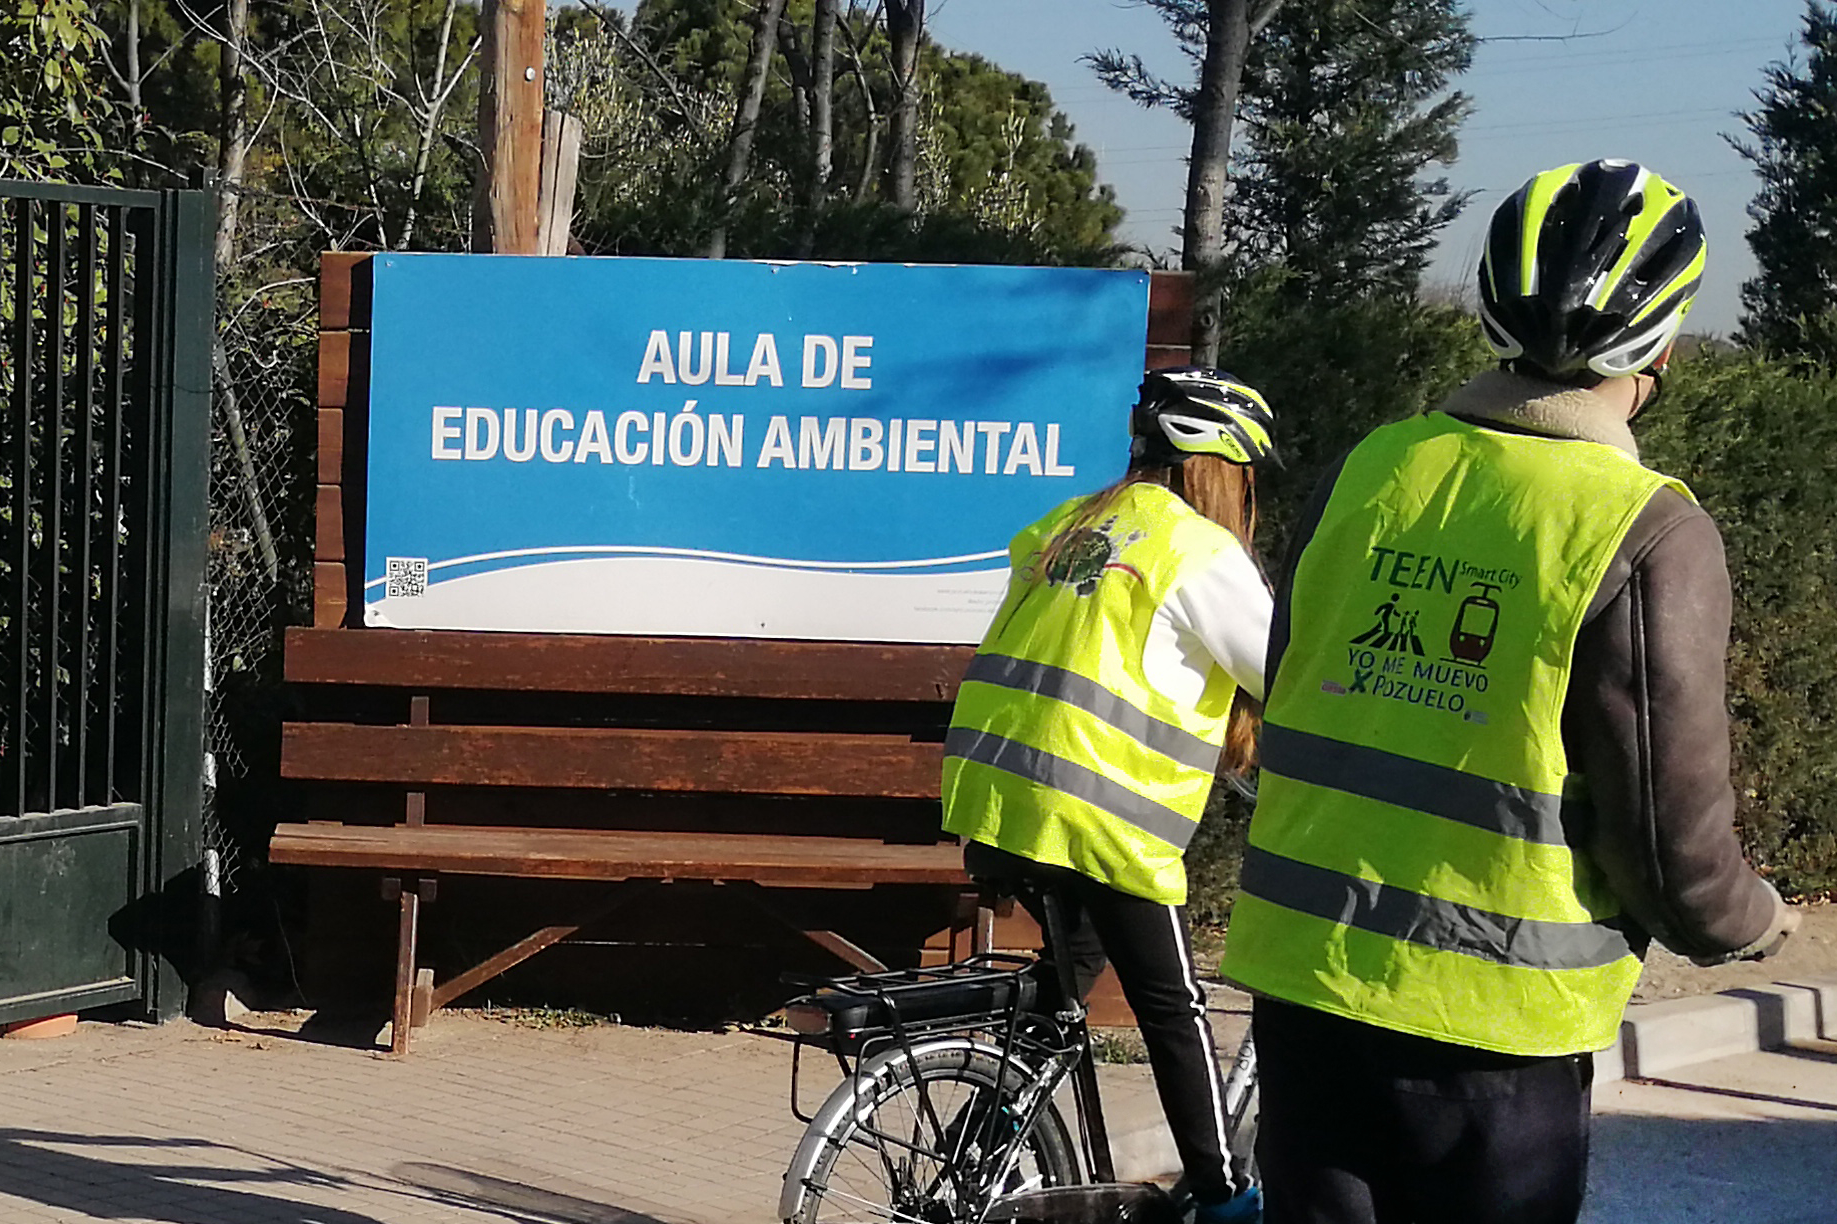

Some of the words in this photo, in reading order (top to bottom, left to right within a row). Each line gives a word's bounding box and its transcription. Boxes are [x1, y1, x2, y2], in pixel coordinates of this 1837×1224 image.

[637, 329, 783, 389] AULA
[801, 334, 874, 390] DE
[430, 399, 744, 469] EDUCACIÓN
[757, 415, 1075, 477] AMBIENTAL
[1371, 546, 1460, 594] TEEN
[1460, 561, 1497, 583] Smart
[1498, 568, 1523, 590] City
[1348, 648, 1375, 669] YO
[1383, 656, 1405, 674] ME
[1414, 661, 1488, 693] MUEVO
[1372, 674, 1465, 713] POZUELO
